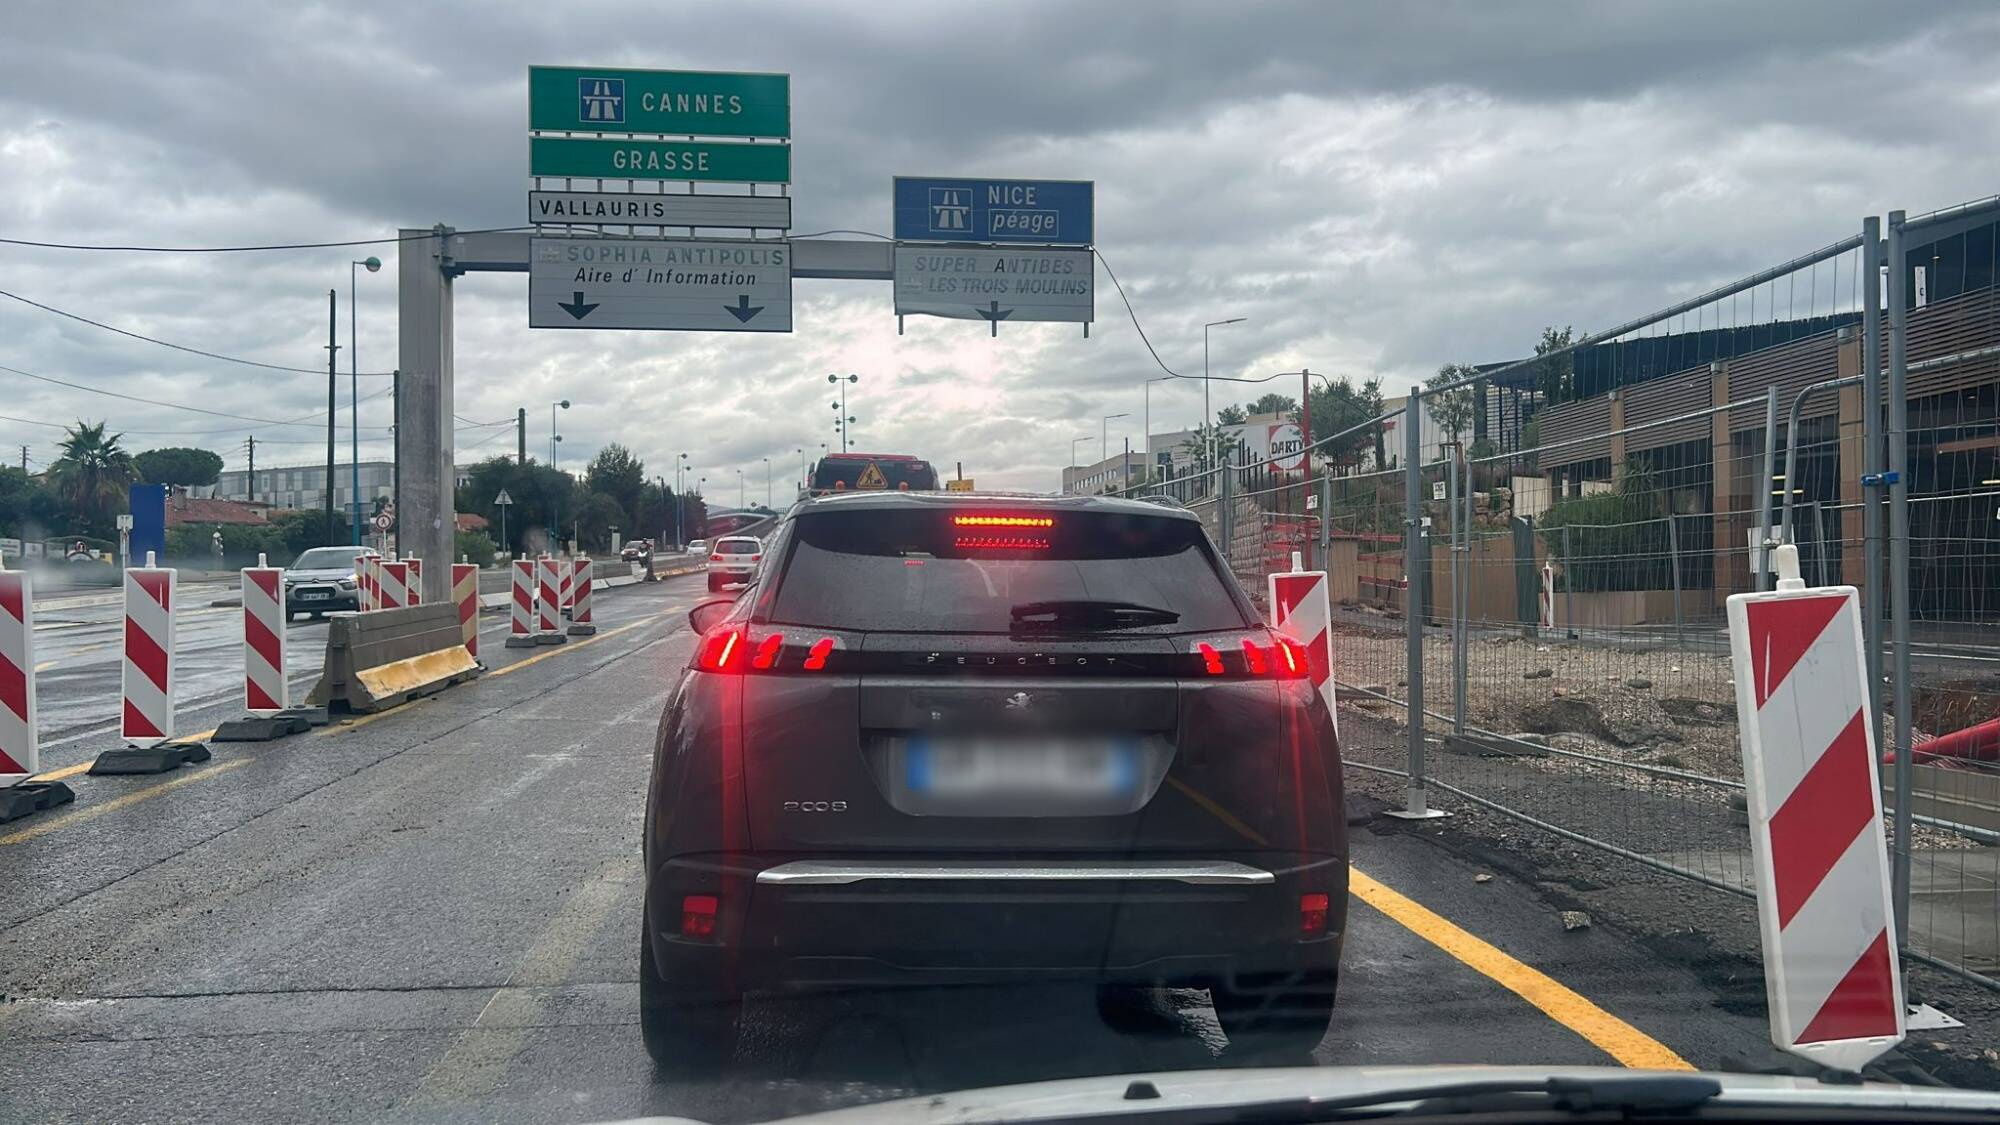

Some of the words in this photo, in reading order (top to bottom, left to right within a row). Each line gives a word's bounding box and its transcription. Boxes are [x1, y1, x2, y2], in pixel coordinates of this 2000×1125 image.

[642, 92, 742, 115] CANNES
[613, 150, 709, 171] GRASSE
[988, 185, 1037, 205] NICE
[540, 199, 665, 217] VALLAURIS
[992, 211, 1055, 232] péage
[567, 246, 652, 263] SOPHIA
[666, 248, 784, 265] ANTIPOLIS
[915, 256, 976, 273] SUPER
[994, 258, 1074, 274] ANTIBES
[574, 267, 612, 283] Aire
[646, 268, 756, 285] Information
[928, 277, 958, 293] LES
[962, 277, 1009, 294] TROIS
[1015, 278, 1087, 295] MOULINS
[1271, 439, 1304, 454] DARTY
[927, 656, 1116, 665] PEUGEOT
[783, 801, 848, 812] 2008
